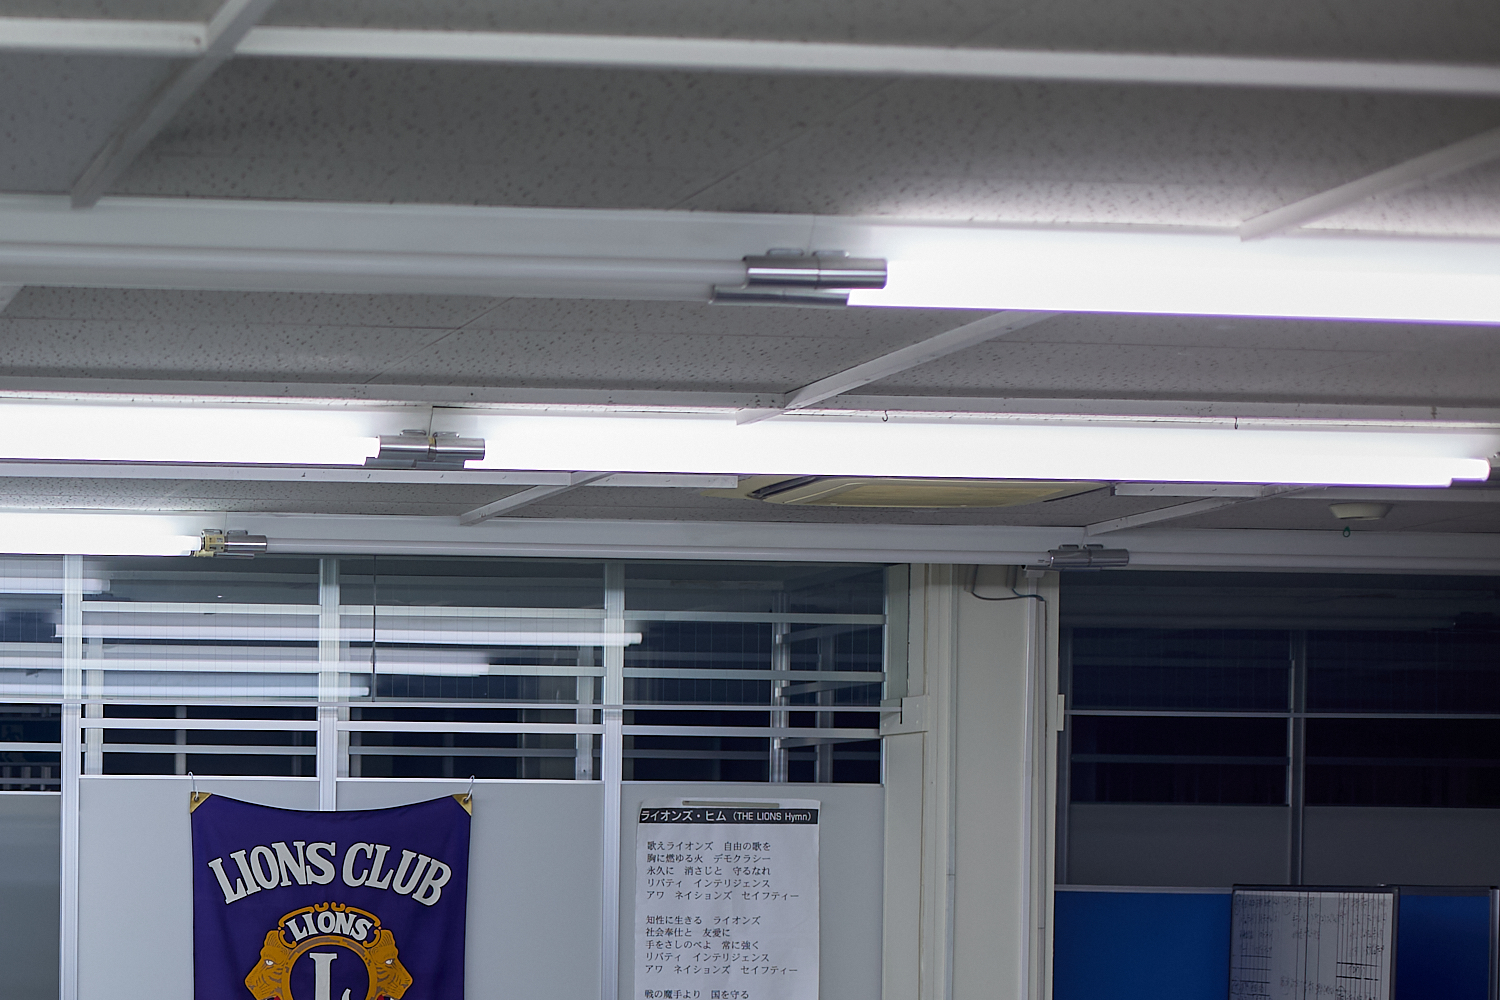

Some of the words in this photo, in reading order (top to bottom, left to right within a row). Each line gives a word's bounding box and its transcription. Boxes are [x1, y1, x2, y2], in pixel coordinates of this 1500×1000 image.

[641, 810, 726, 822] ライオンズ・ヒム
[757, 811, 781, 821] LIONS
[648, 841, 713, 850] 歌えライオンズ
[725, 842, 770, 851] 自由の歌を
[647, 854, 703, 863] 胸に燃ゆる火
[714, 854, 770, 863] デモクラシー
[208, 841, 336, 904] LIONS
[342, 843, 451, 906] CLUB
[685, 866, 722, 875] 消さじと
[733, 866, 770, 876] 守るなれ
[648, 879, 682, 888] リバティ
[694, 879, 770, 888] インテリジェンス
[647, 891, 664, 899] アワ
[675, 891, 732, 900] ネイションズ
[742, 892, 798, 900] セイフティー
[646, 915, 702, 925] 知性に生きる
[714, 916, 760, 925] ライオンズ
[286, 911, 373, 941] LIONS
[646, 927, 691, 937] 社会奉仕と
[703, 928, 730, 937] 友愛に
[646, 940, 711, 949] 手をさしのべよ
[722, 940, 758, 950] 常に強く
[647, 952, 680, 961] リバティ
[693, 953, 769, 962] インテリジェンス
[646, 965, 662, 973] アワ
[674, 965, 730, 974] ネイションズ
[741, 966, 797, 975] セイフティー
[645, 990, 700, 999] 戦の魔手より
[711, 990, 748, 999] 国を守る
